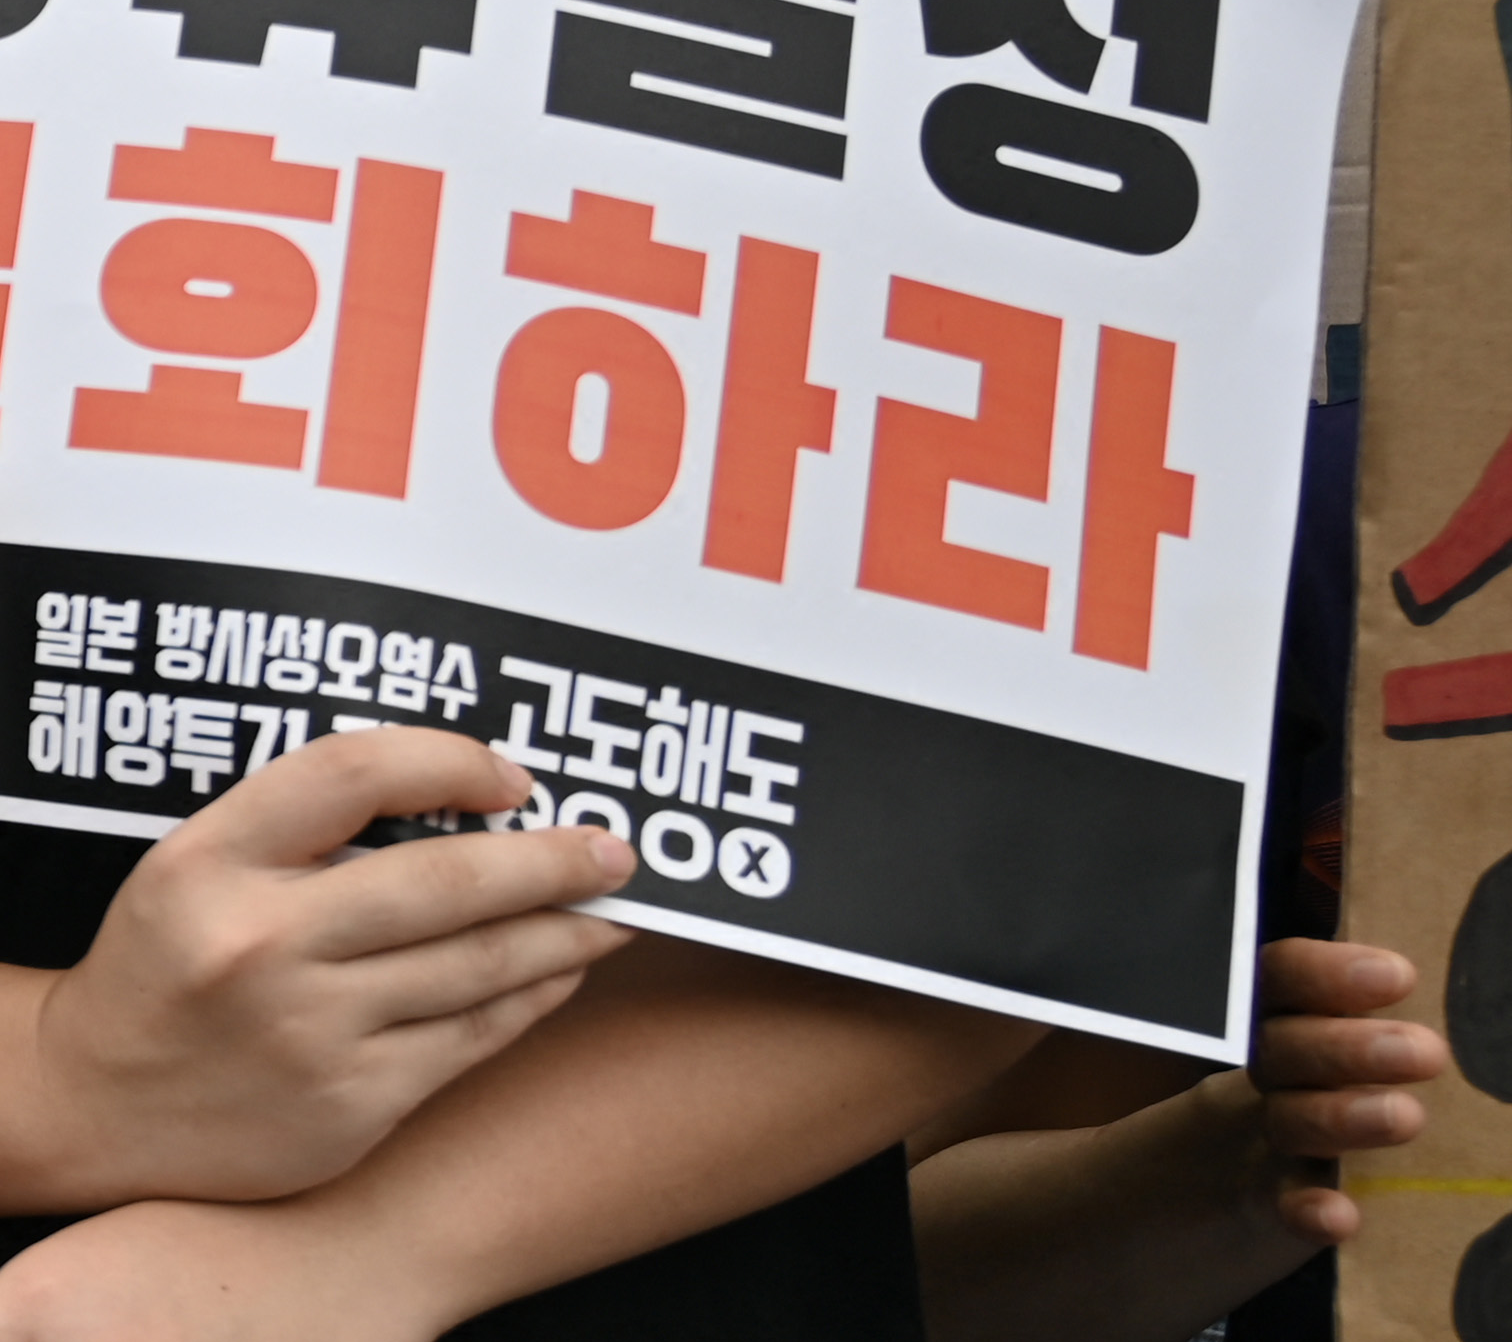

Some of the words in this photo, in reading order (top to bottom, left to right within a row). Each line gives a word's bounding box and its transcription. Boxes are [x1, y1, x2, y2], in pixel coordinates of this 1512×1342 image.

[35, 591, 141, 675] 일본
[154, 602, 480, 721] 방사성오염수
[27, 679, 311, 795] 해양투기
